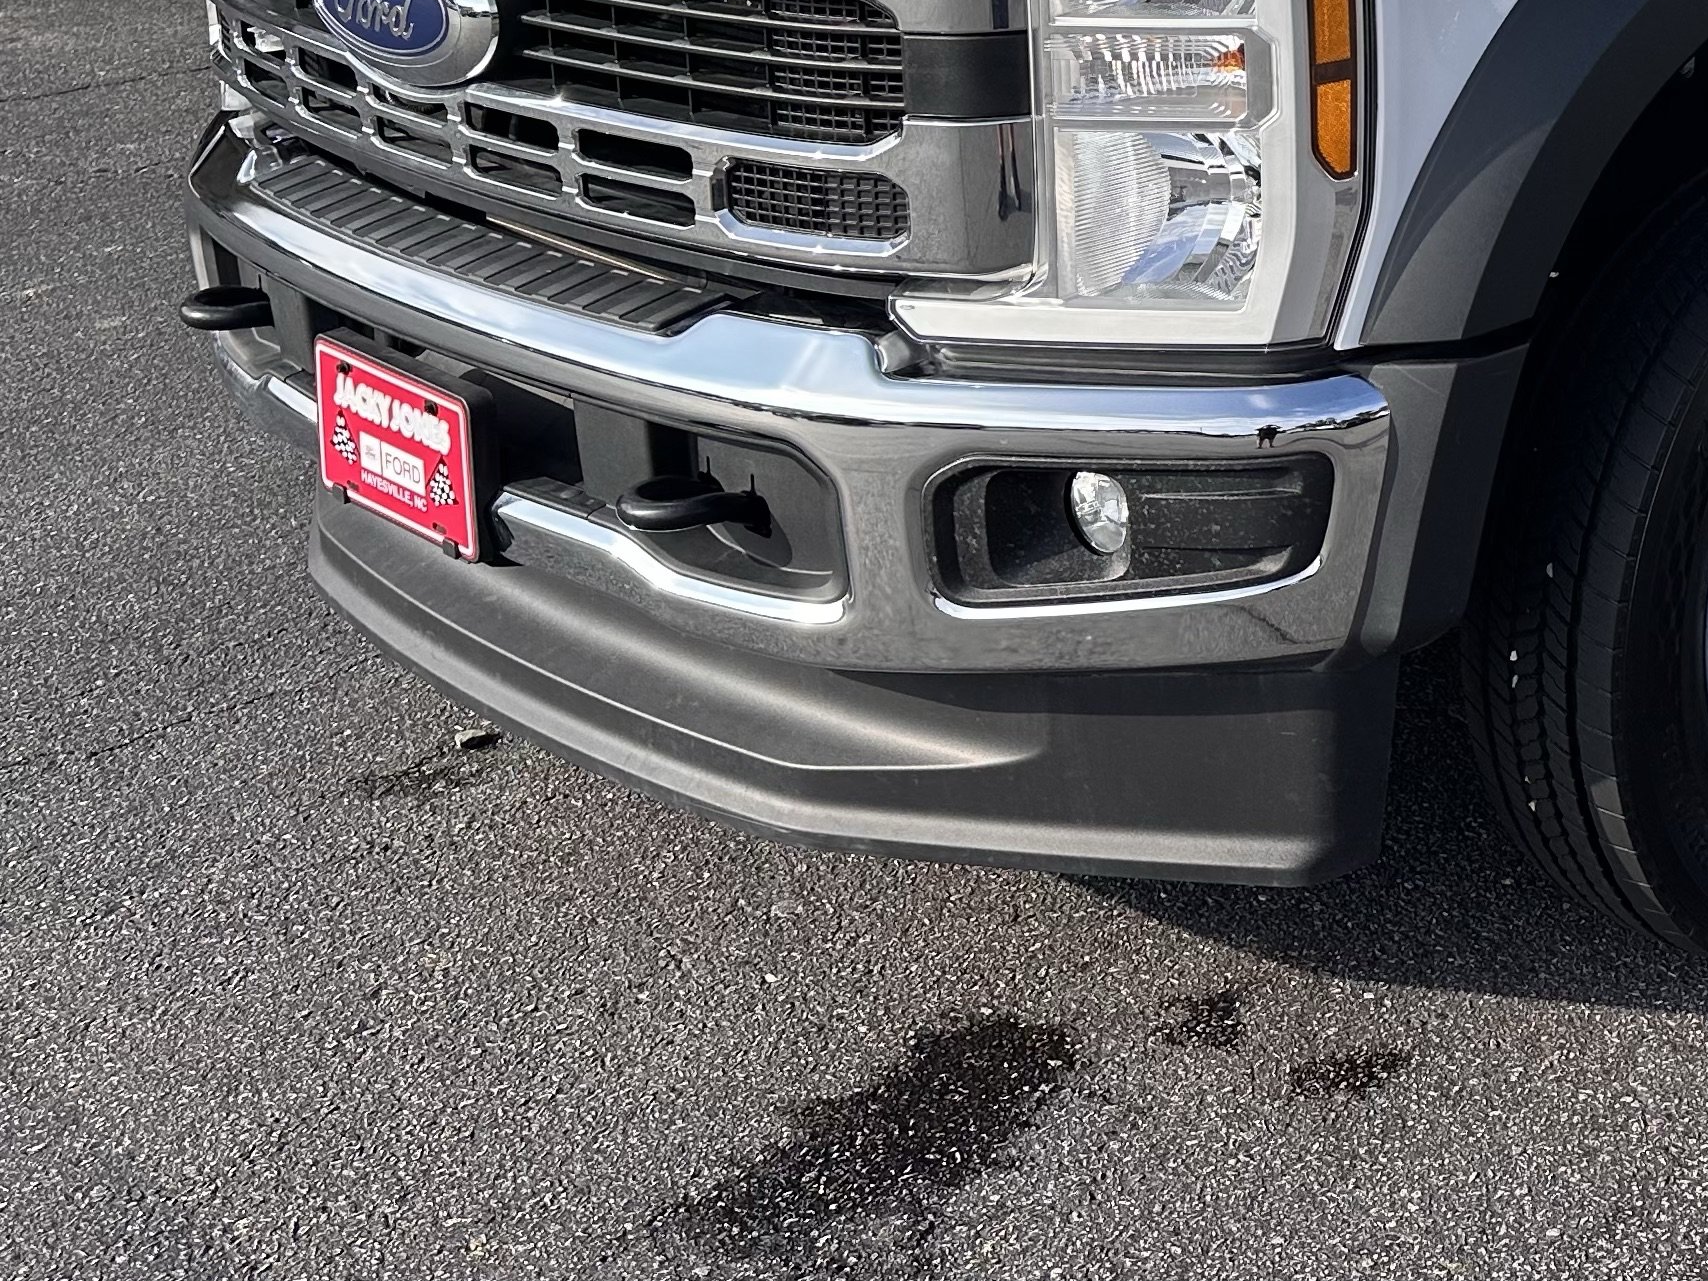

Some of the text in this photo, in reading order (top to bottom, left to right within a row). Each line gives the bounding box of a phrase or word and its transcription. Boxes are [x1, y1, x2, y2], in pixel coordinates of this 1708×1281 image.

[333, 373, 452, 456] JACKY JONES
[385, 452, 421, 484] FORD
[414, 494, 428, 513] NC
